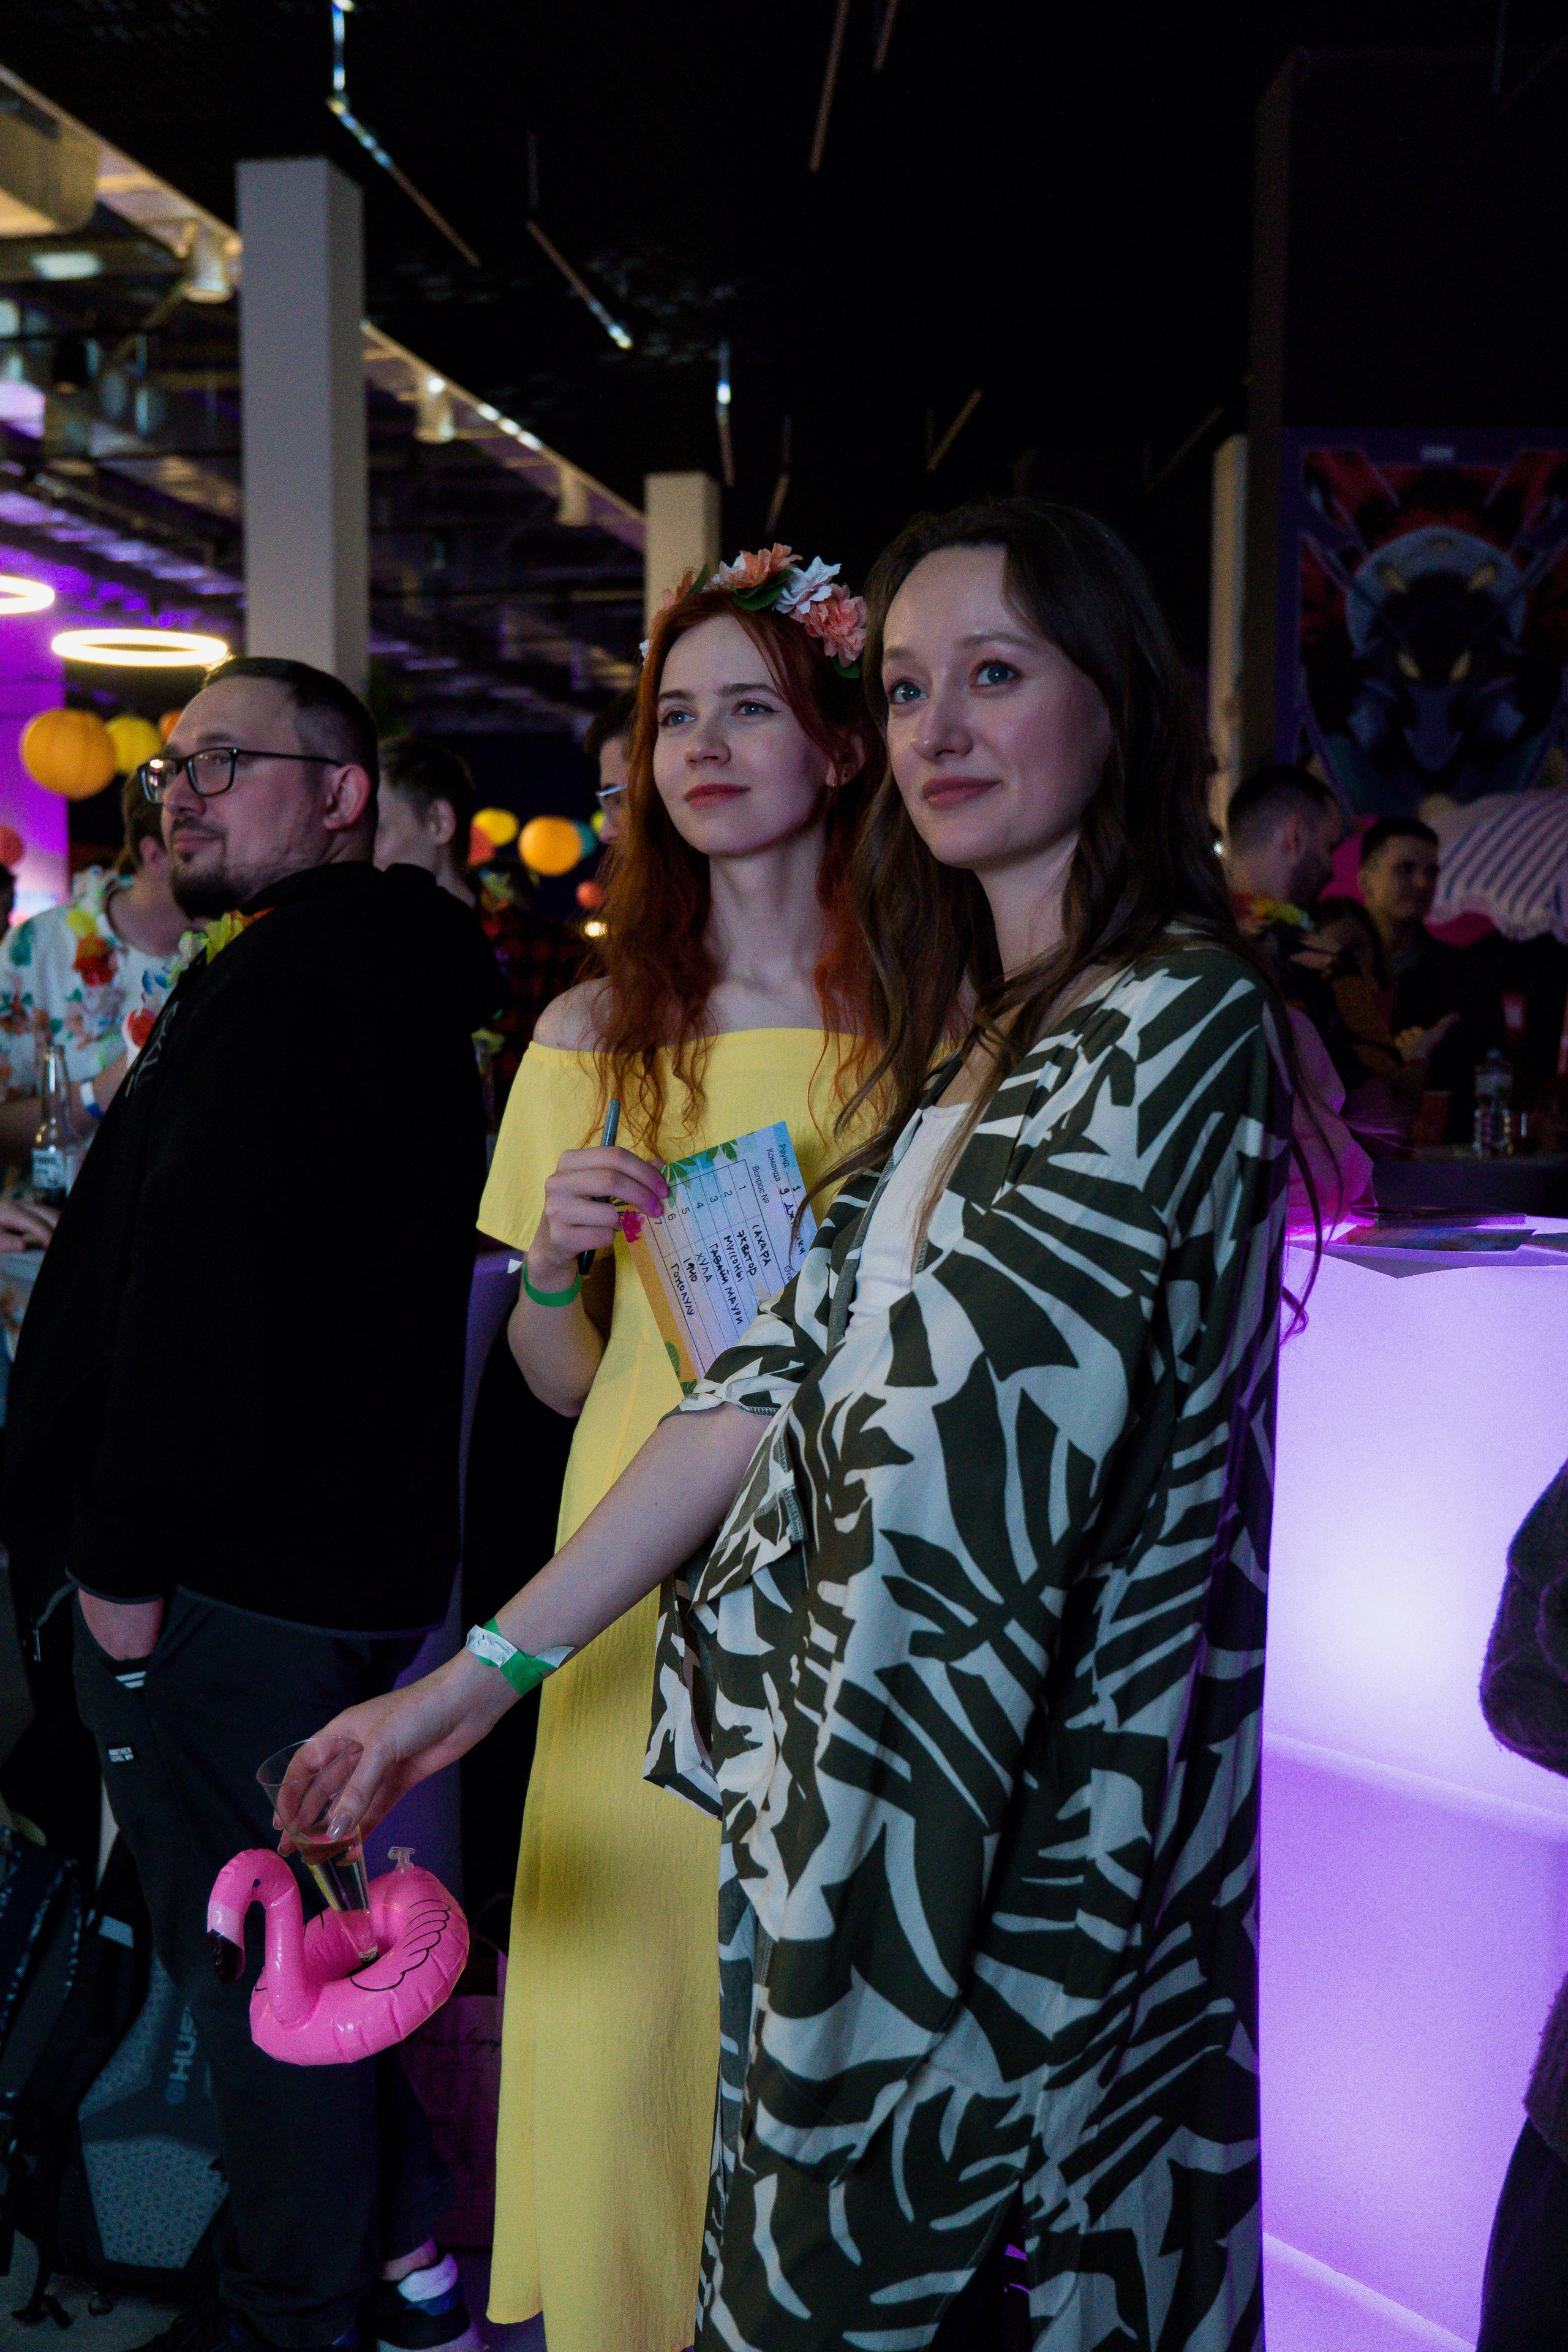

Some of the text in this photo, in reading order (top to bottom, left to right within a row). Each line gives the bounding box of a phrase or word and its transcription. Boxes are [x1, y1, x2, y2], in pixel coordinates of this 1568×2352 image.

[767, 1148, 780, 1182] Команда
[779, 1144, 790, 1167] Раунд
[752, 1165, 765, 1194] Вопрос
[695, 1252, 712, 1282] ХУЛА
[737, 1229, 756, 1276] ЭКВАТОР
[671, 1263, 695, 1315] ГОНОЛУЛУ
